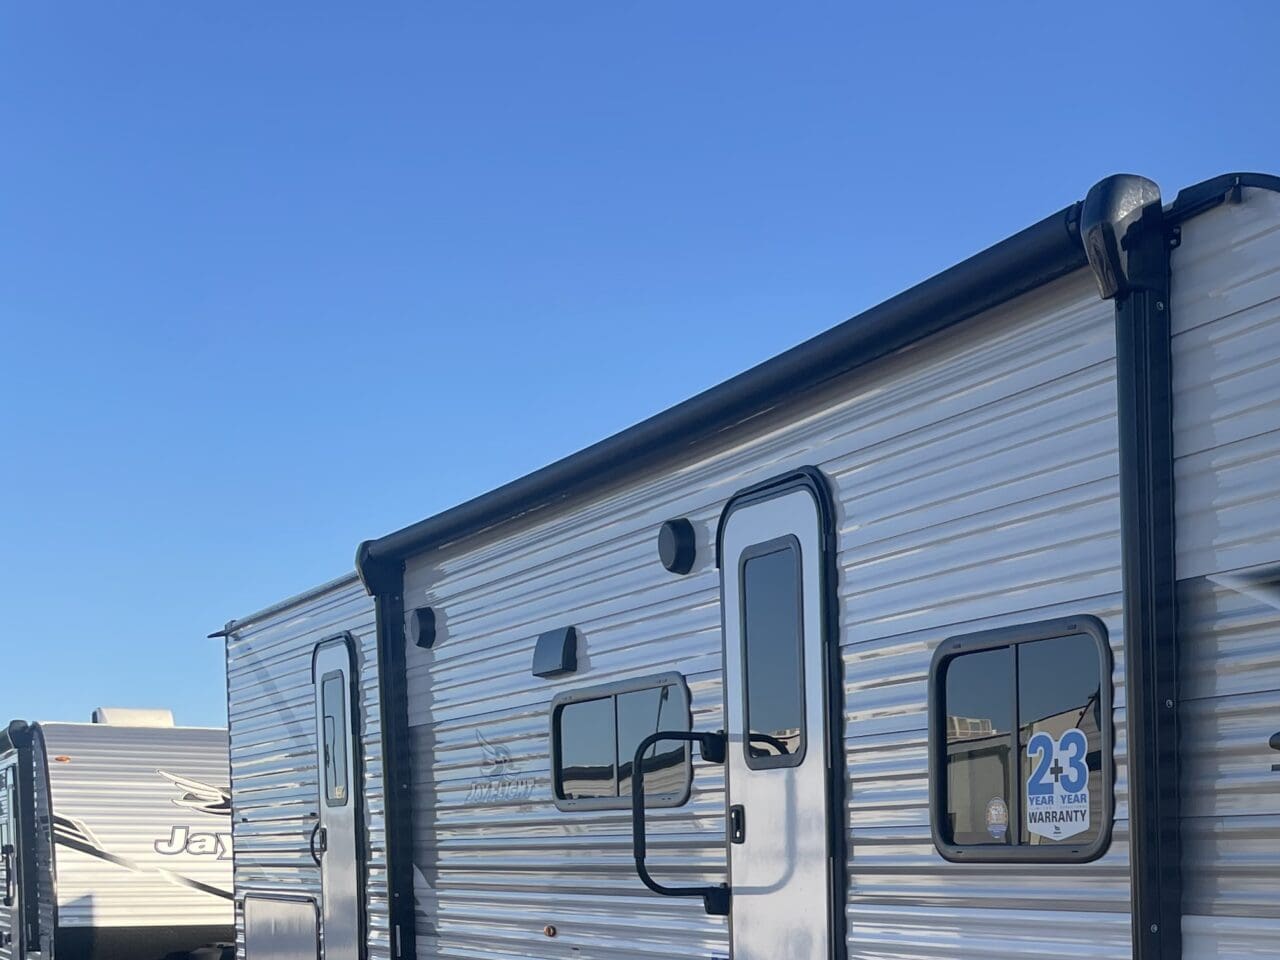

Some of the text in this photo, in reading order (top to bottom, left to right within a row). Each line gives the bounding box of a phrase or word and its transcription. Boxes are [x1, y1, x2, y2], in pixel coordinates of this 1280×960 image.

[1029, 793, 1087, 806] YEAR YEAR
[1029, 809, 1087, 824] WARRANTY
